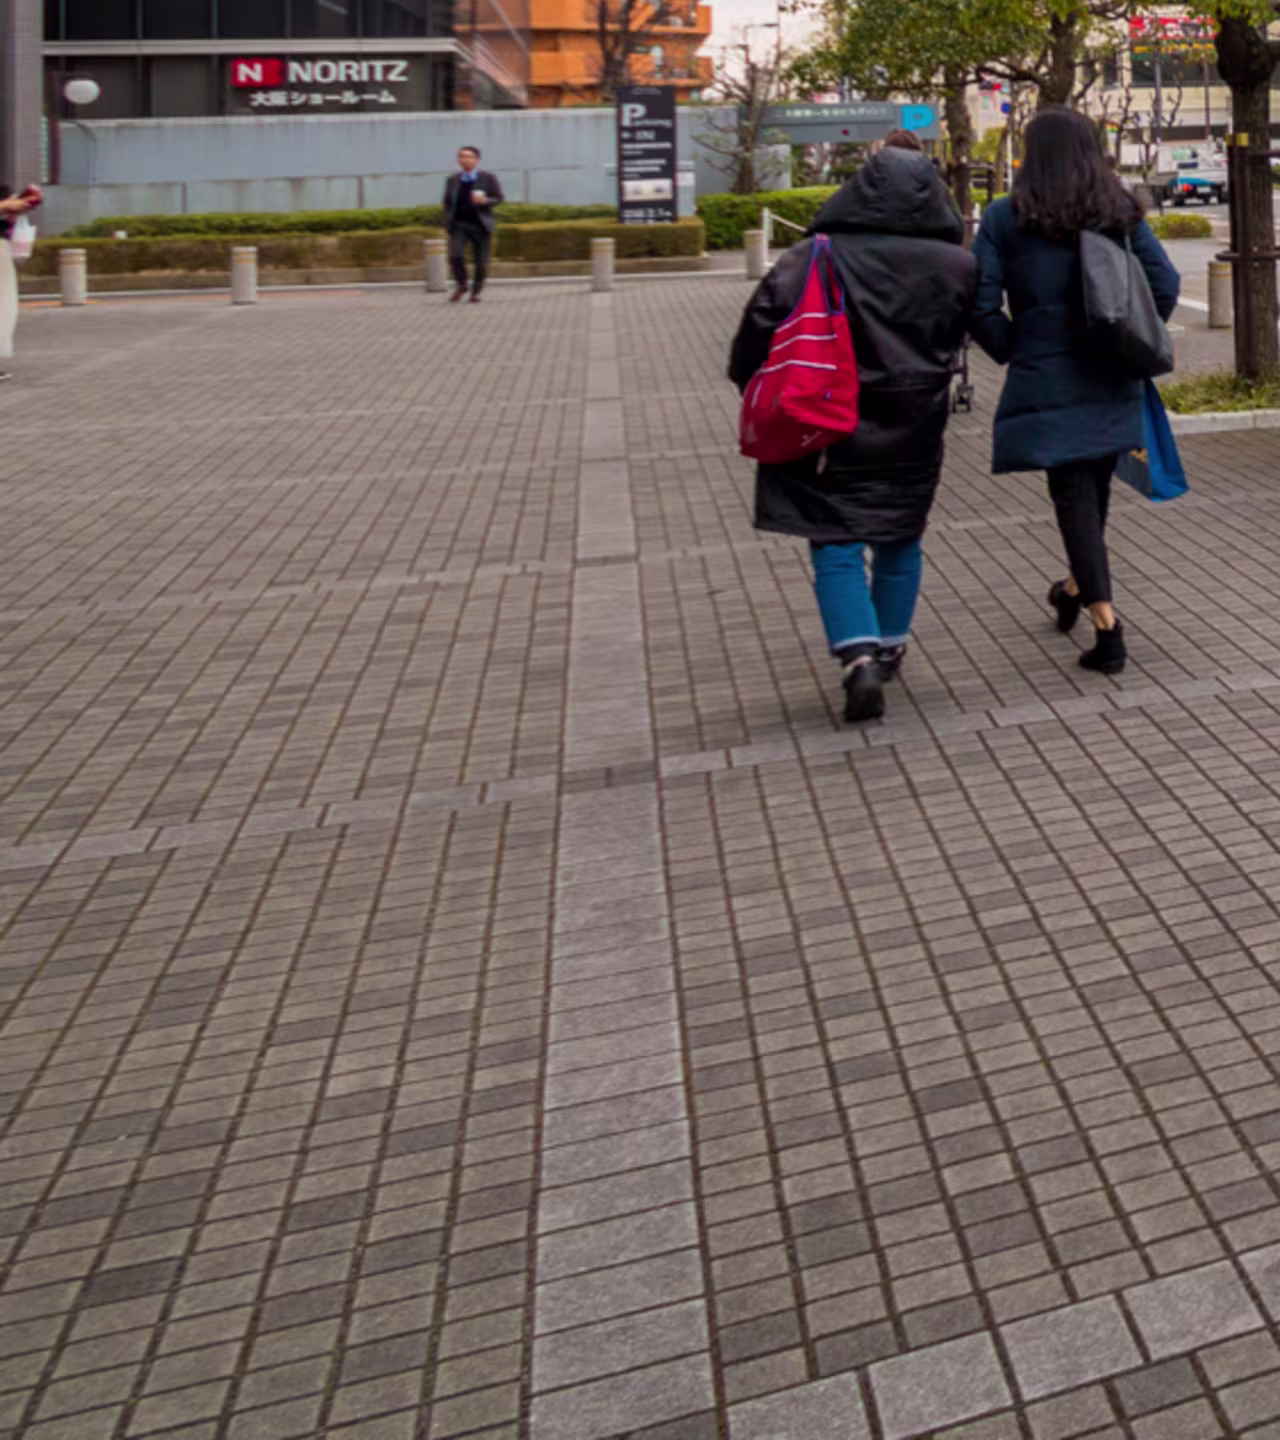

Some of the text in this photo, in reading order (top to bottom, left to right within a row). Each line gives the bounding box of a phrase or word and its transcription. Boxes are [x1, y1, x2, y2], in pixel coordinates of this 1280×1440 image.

[237, 60, 409, 83] N NORITZ
[250, 90, 397, 107] 大阪ショールーム
